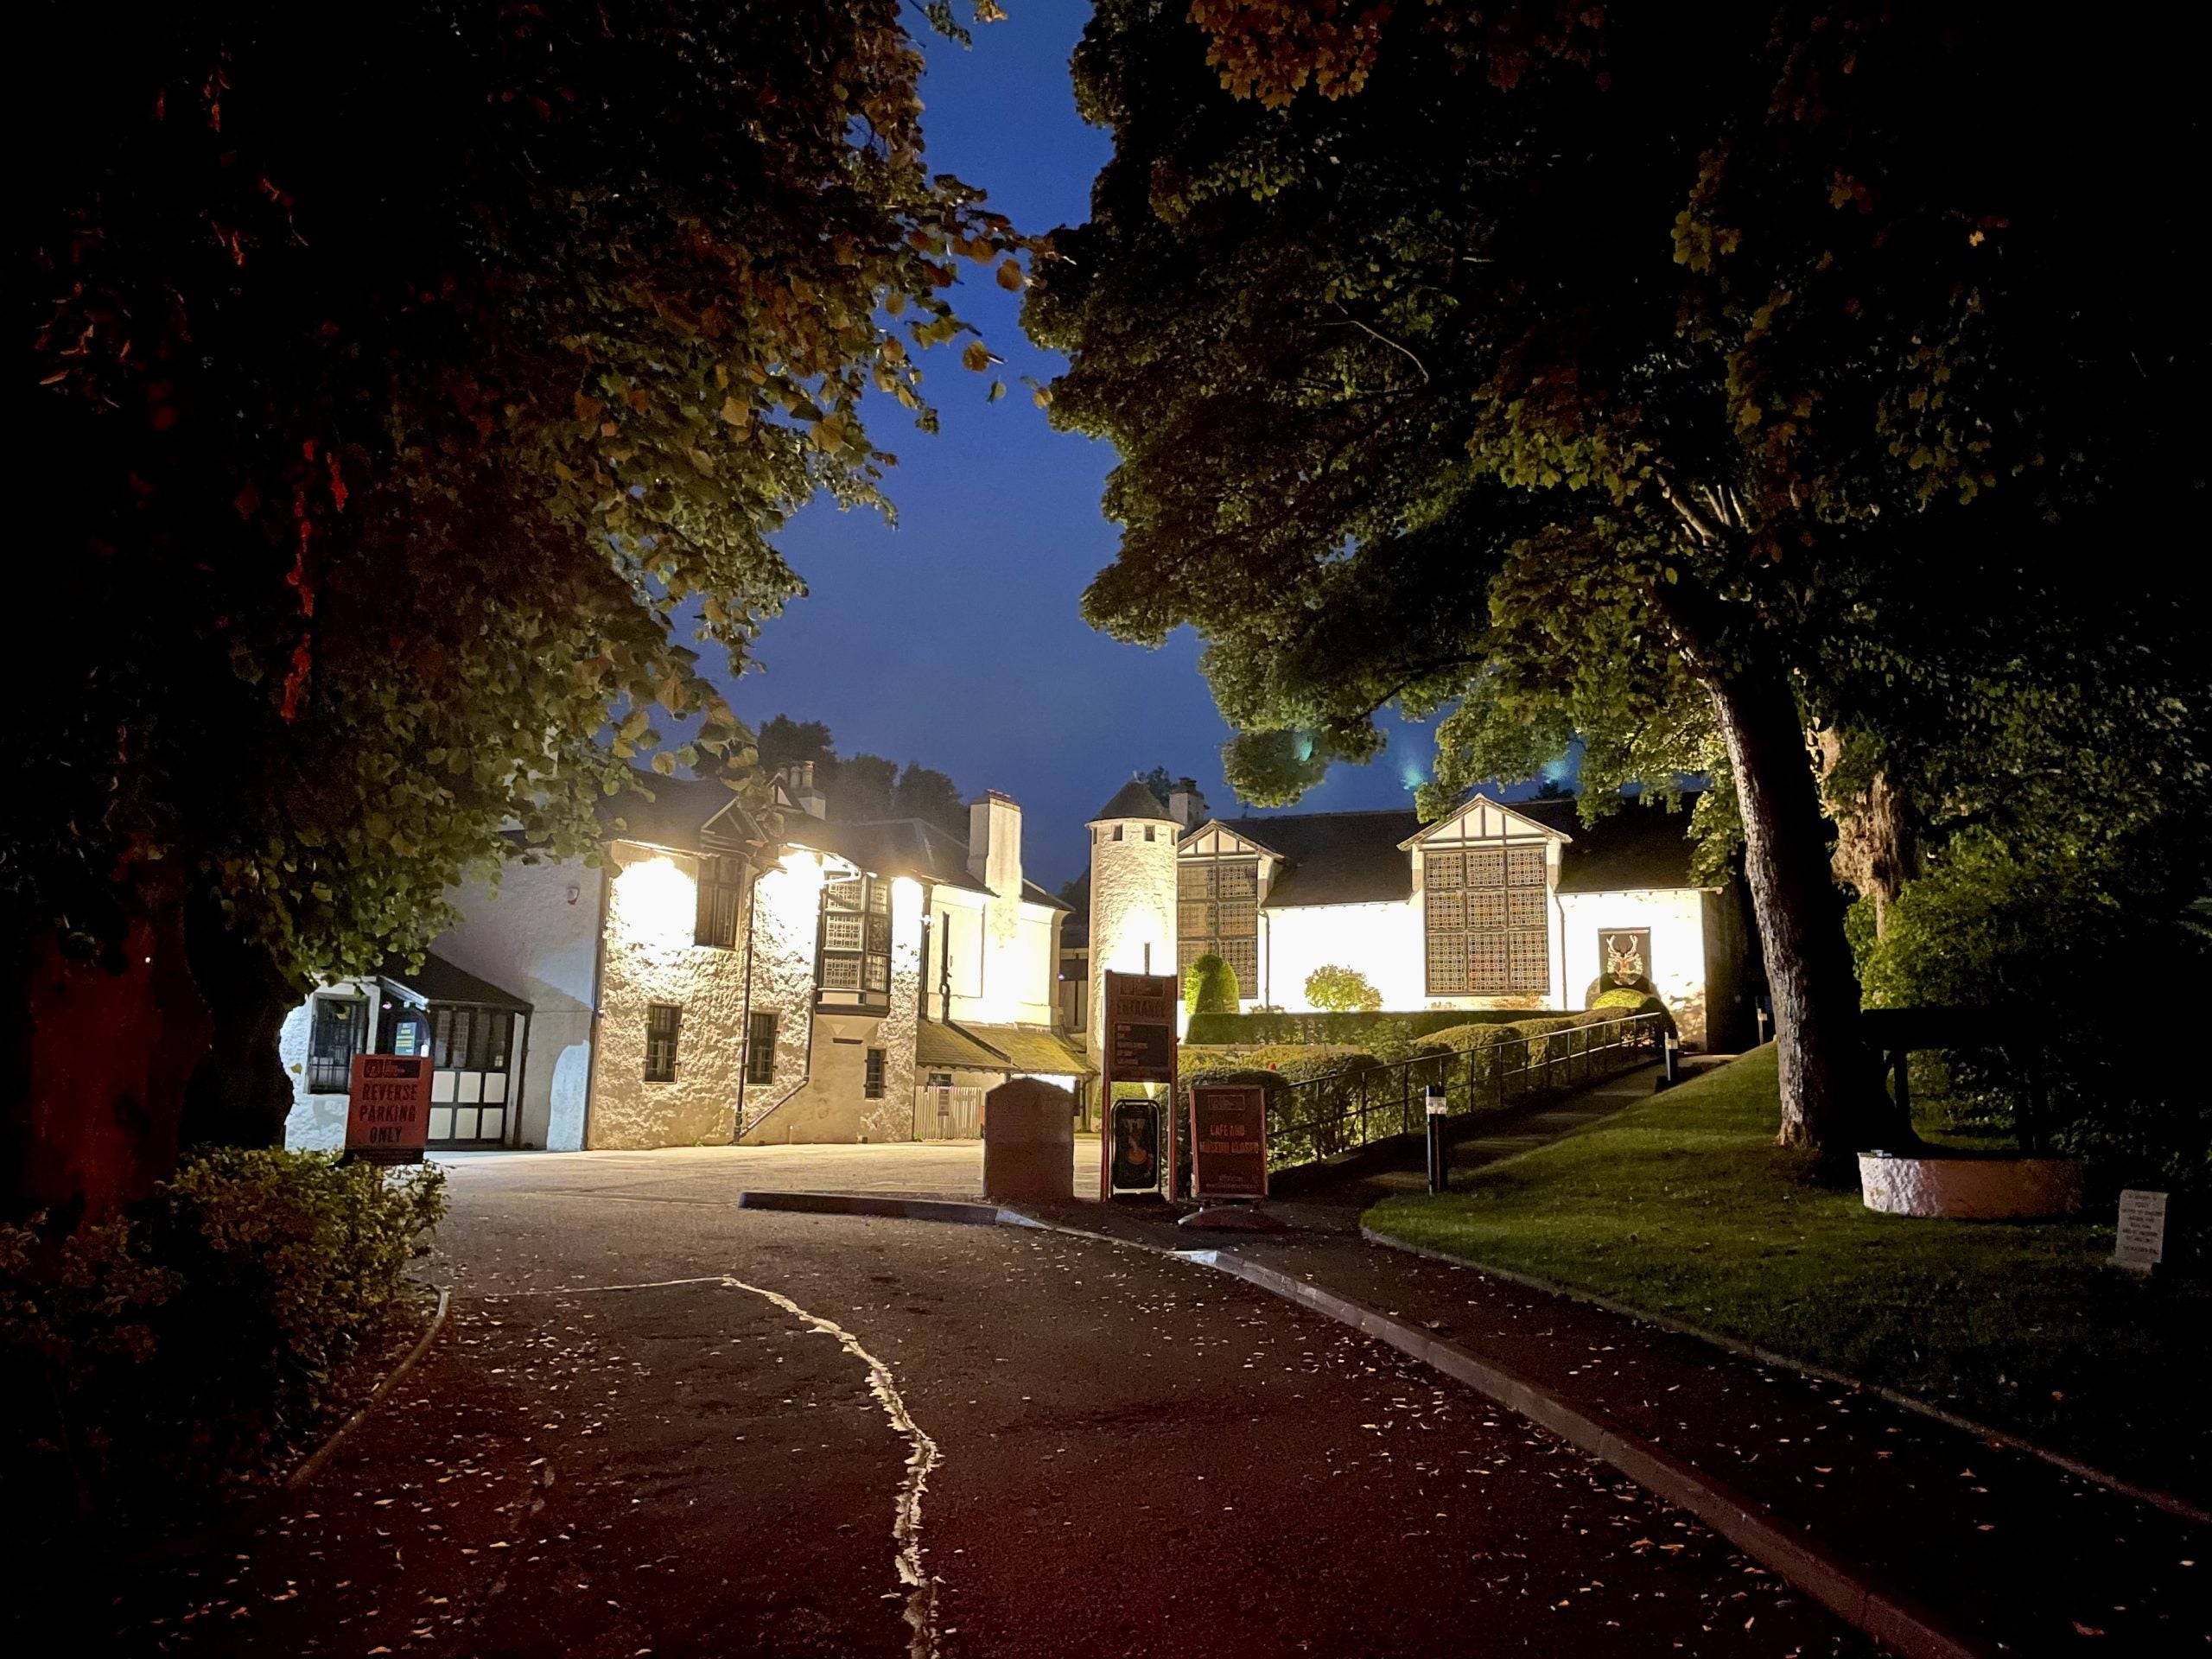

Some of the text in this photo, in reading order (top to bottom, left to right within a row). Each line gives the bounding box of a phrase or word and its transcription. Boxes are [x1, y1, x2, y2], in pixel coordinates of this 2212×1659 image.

[1117, 1000, 1166, 1017] ENTRANCE
[362, 1084, 418, 1101] REVERSE
[359, 1105, 416, 1122] PARKING
[370, 1126, 402, 1143] ONLY
